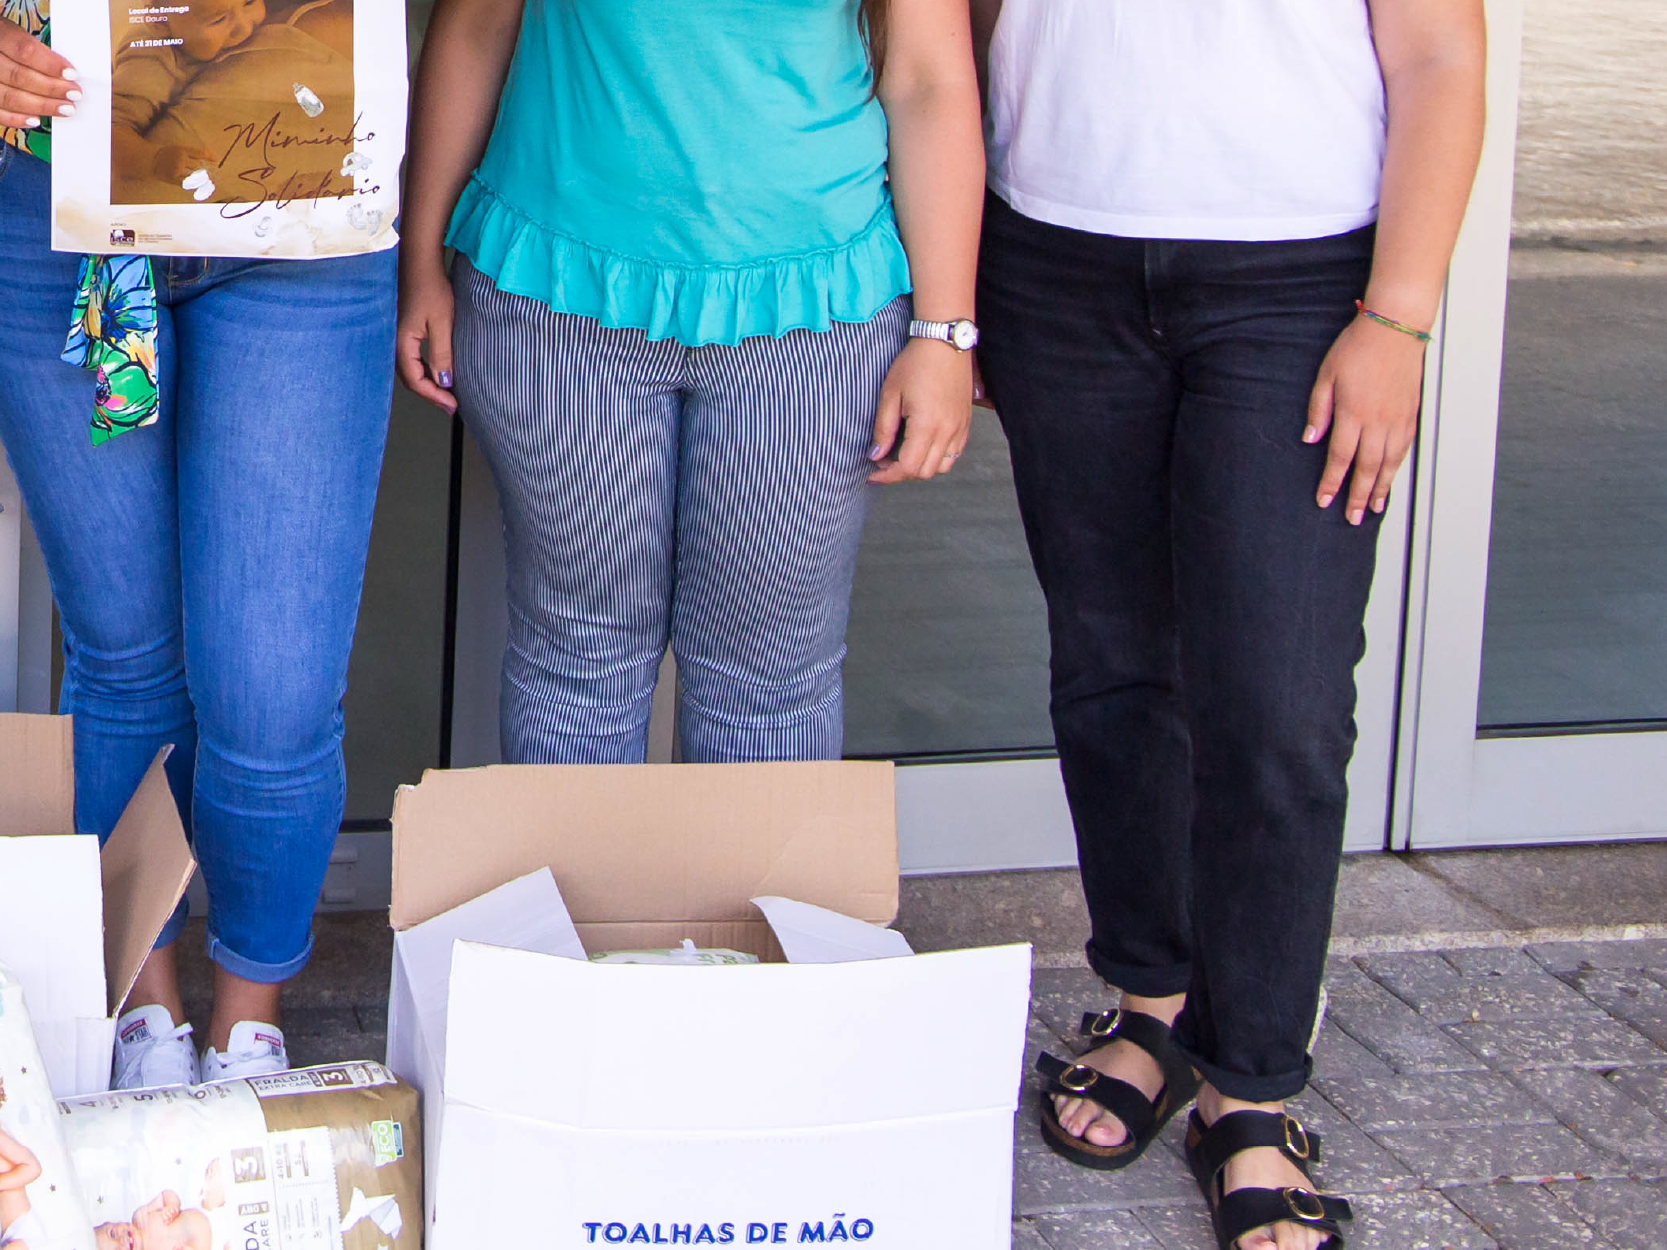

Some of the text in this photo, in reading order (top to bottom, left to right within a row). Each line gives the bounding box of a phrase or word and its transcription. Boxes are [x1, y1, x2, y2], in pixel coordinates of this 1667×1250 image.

[254, 1075, 309, 1086] FRALDA
[582, 1212, 874, 1245] TOALHAS DE MÃO
